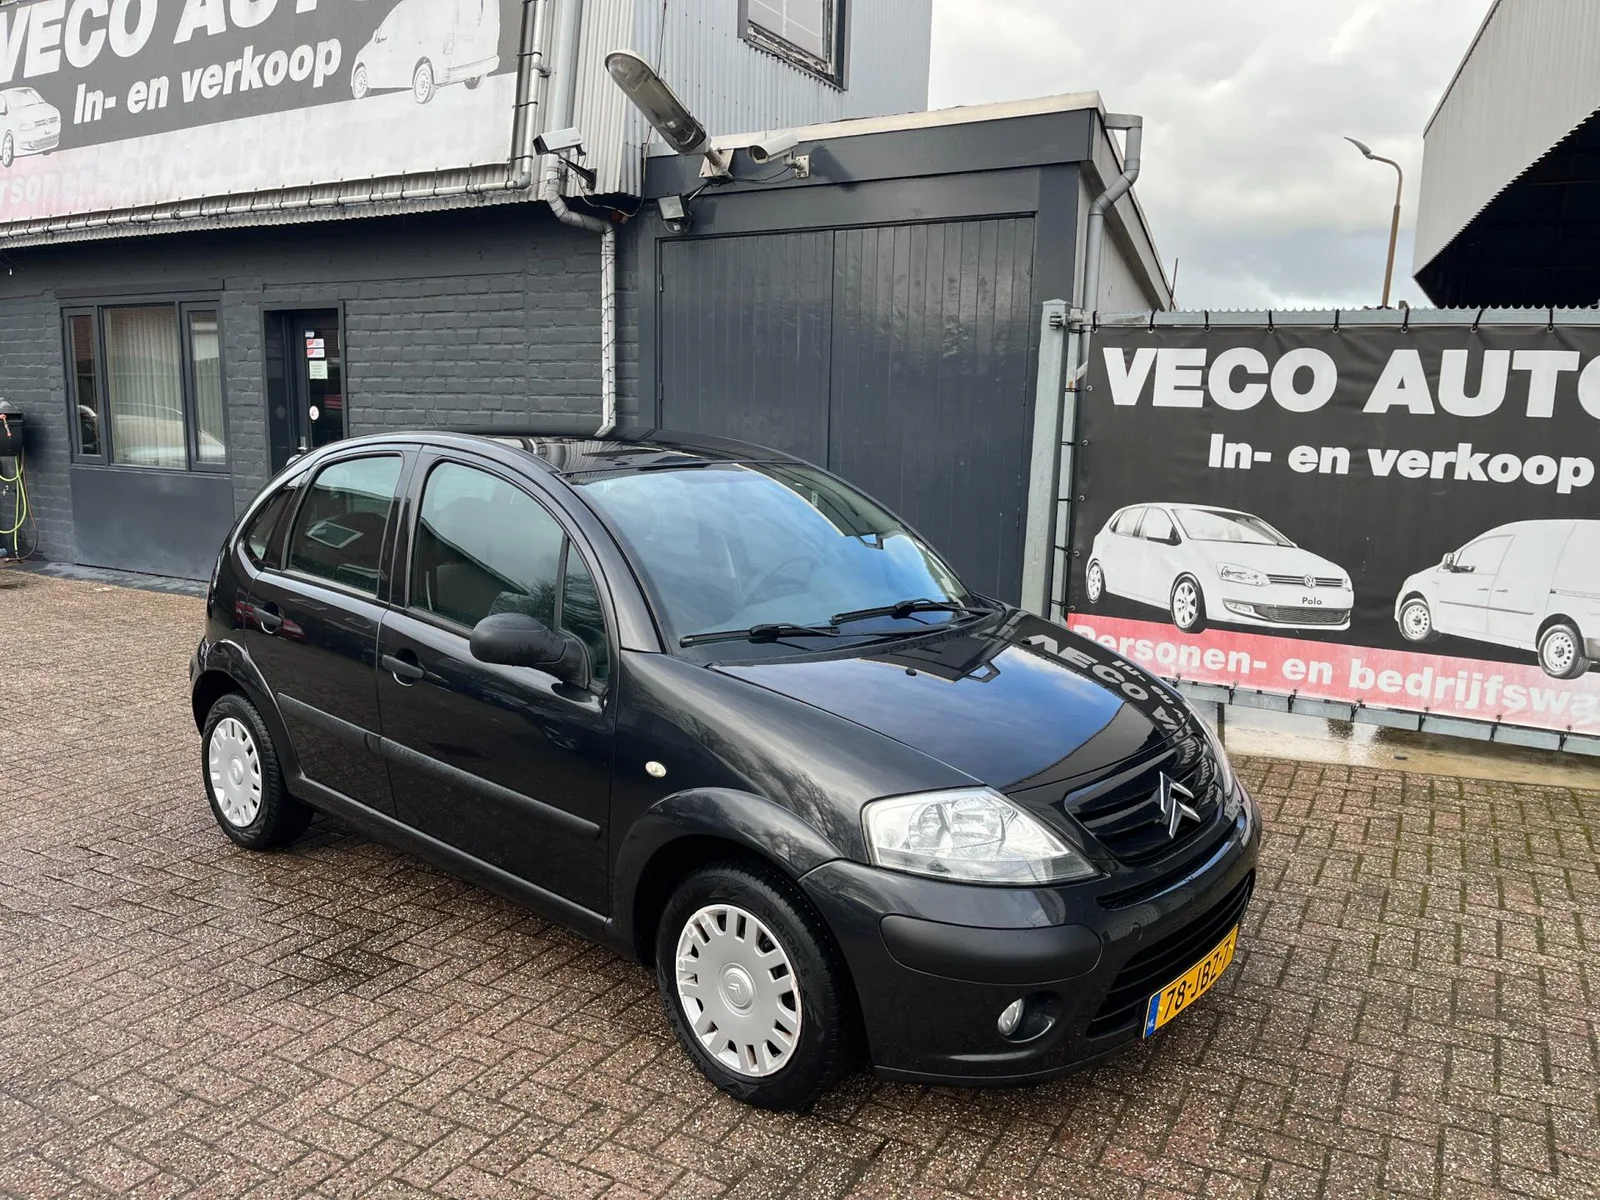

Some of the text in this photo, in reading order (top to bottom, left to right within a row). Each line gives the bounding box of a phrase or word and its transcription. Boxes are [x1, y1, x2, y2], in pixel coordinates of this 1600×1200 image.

[0, 0, 158, 84] VECO
[73, 38, 342, 125] In- en verkoop
[1102, 347, 1339, 413] VECO
[1208, 433, 1595, 494] In- en verkoop
[1302, 596, 1323, 606] Polo
[1282, 654, 1333, 686] en
